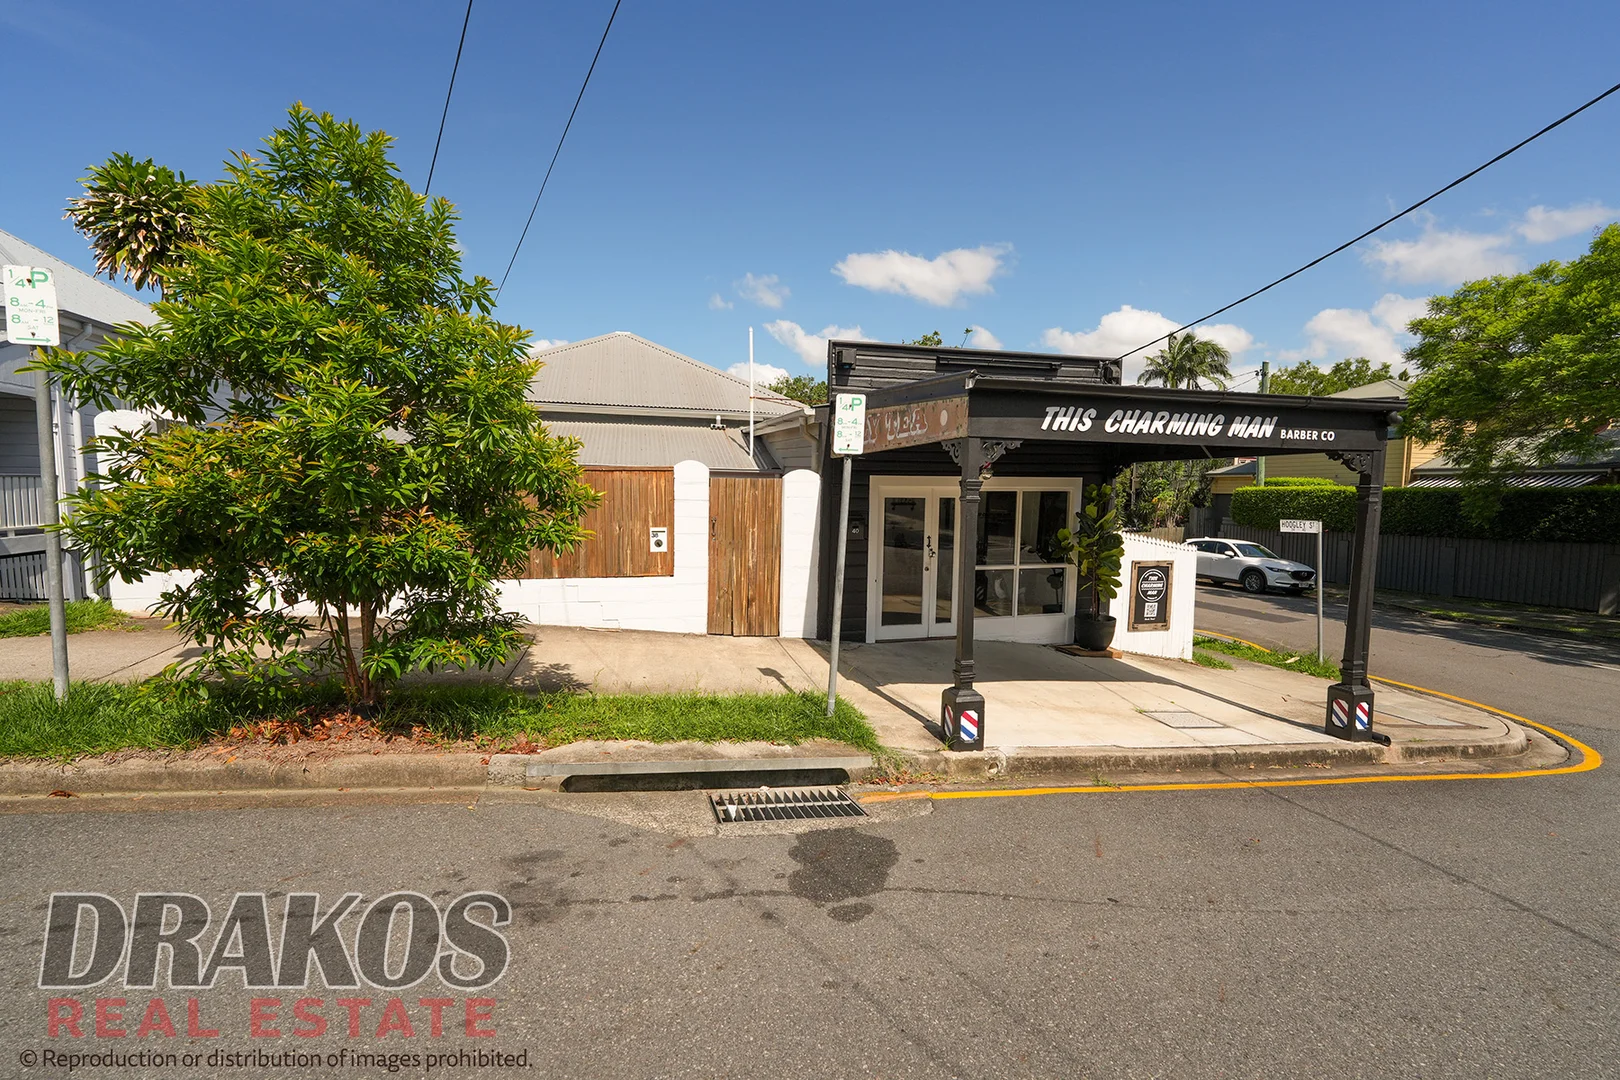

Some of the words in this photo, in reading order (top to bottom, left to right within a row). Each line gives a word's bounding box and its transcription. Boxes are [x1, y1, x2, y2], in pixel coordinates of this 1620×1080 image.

[1041, 406, 1097, 432] THIS
[1104, 409, 1225, 437] CHARMING
[1227, 415, 1278, 439] MAN
[1280, 429, 1318, 440] BARBER
[1320, 431, 1335, 441] CO
[1281, 520, 1306, 529] HOOGLEY
